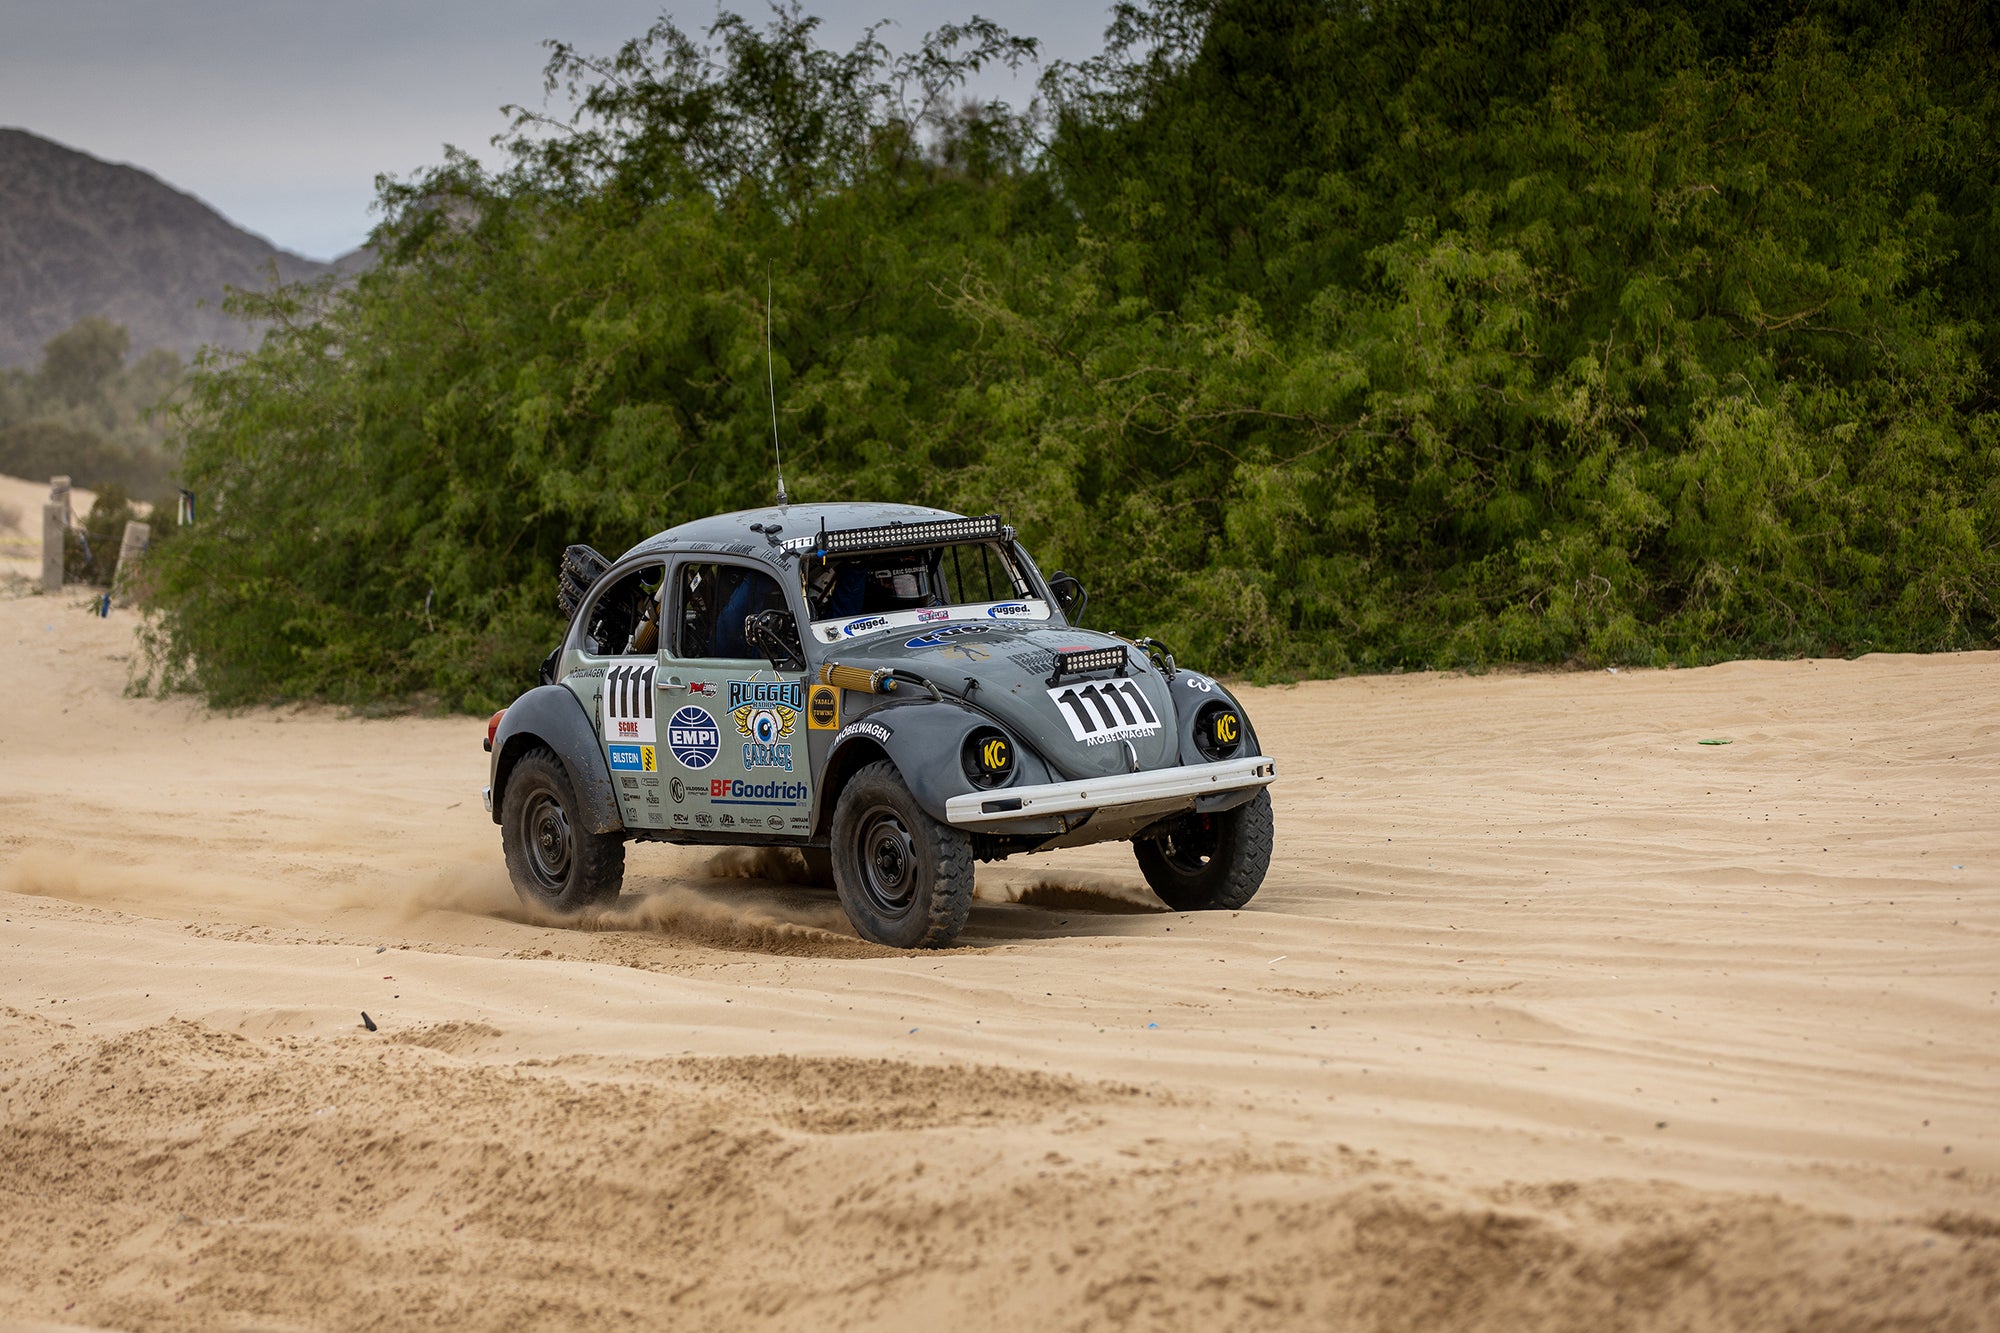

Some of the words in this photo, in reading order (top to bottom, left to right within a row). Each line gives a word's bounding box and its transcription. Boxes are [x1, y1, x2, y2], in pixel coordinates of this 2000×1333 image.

[607, 665, 656, 719] 1111
[729, 681, 804, 709] RUGGED
[752, 701, 777, 709] RADIOS
[1057, 681, 1157, 734] 1111
[618, 721, 639, 733] SCORE
[671, 729, 716, 746] EMPI
[833, 720, 891, 747] MÖBELWAGEN
[1216, 713, 1237, 743] KC
[612, 751, 640, 764] BILSTEIN
[743, 743, 793, 772] GARAGE
[983, 739, 1007, 769] KC
[671, 779, 683, 801] KC
[710, 778, 808, 800] BFGoodrich
